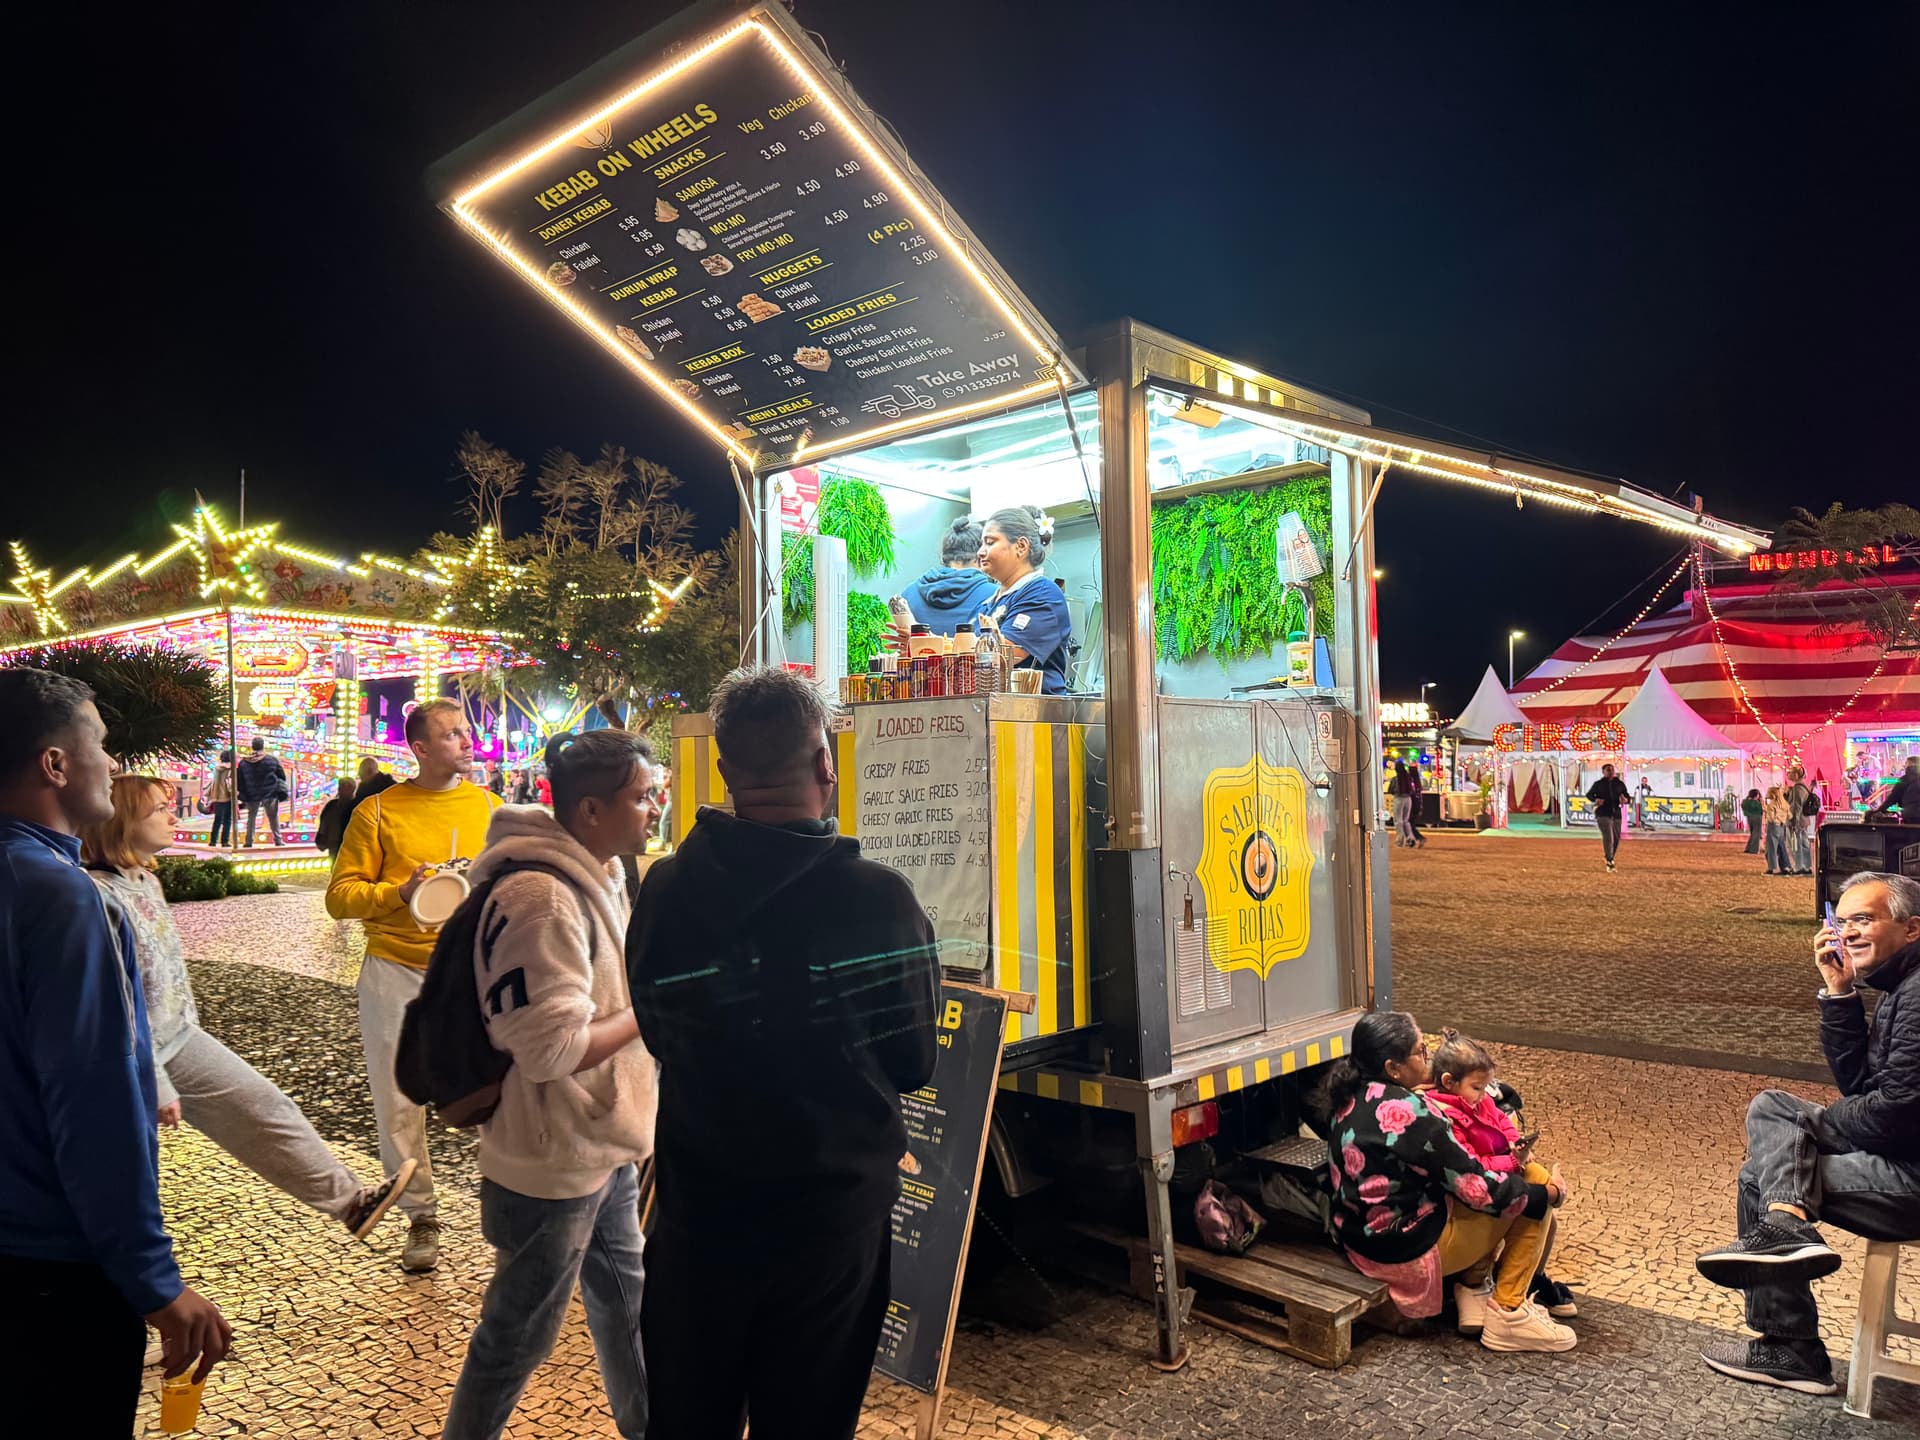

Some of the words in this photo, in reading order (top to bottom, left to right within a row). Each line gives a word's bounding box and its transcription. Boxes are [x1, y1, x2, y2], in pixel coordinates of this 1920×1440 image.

[737, 118, 765, 135] Veg
[768, 93, 814, 121] Chickan
[760, 141, 787, 160] 3.50
[798, 121, 826, 141] 3.90
[535, 169, 599, 212] KEBAB
[596, 151, 632, 177] ON
[627, 103, 718, 160] WHEELS
[653, 148, 707, 181] SNACKS
[675, 176, 719, 202] SAMOSA
[796, 179, 821, 197] 4.50
[834, 160, 861, 179] 4.90
[538, 217, 576, 241] DONER
[573, 198, 612, 222] KEBAB
[823, 209, 849, 226] 4.50
[863, 191, 888, 210] 4.90
[618, 215, 640, 231] 5.95
[708, 213, 746, 236] MO:MO
[868, 230, 884, 244] (4
[885, 218, 915, 237] Pic)
[630, 228, 653, 243] 5.95
[900, 234, 927, 252] 2.25
[559, 241, 591, 260] Chicken
[736, 247, 758, 263] FRY
[756, 233, 794, 255] MO:MO
[912, 249, 938, 265] 3.00
[572, 254, 601, 272] Falafel
[760, 254, 823, 285] NUGGETS
[609, 278, 649, 301] DURUM
[646, 265, 679, 286] WRAP
[774, 280, 813, 299] Chicken
[639, 287, 678, 308] KEBAB
[701, 295, 723, 308] 6.50
[787, 293, 821, 313] Falafel
[714, 307, 735, 320] 6.50
[805, 306, 857, 331] LOADED
[858, 293, 897, 314] FRIES
[641, 316, 674, 332] Chicken
[822, 329, 852, 346] Crispy
[852, 322, 877, 337] Fries
[653, 328, 683, 344] Falafel
[833, 341, 864, 358] Garlic
[863, 334, 893, 350] Sauce
[891, 325, 918, 342] Fries
[684, 356, 722, 373] KEBAB
[719, 346, 746, 361] BOX
[762, 353, 783, 367] 7.50
[844, 353, 880, 369] Cheesy
[878, 344, 908, 361] Garlic
[906, 336, 934, 352] Fries
[856, 364, 893, 379] Chicken
[893, 352, 928, 369] Loaded
[927, 345, 954, 361] Fries
[702, 372, 734, 387] Chicken
[773, 365, 795, 378] 7.50
[784, 375, 806, 388] 7.95
[916, 366, 965, 389] Take
[968, 352, 1020, 376] Away
[713, 383, 742, 397] Falafel
[955, 370, 1021, 394] 913335274
[746, 408, 778, 423] MENU
[776, 398, 813, 415] DEALS
[759, 423, 782, 435] Drink
[780, 421, 789, 429] &
[788, 416, 809, 428] Fries
[830, 416, 850, 428] 1.00
[769, 433, 795, 445] Water
[1749, 545, 1899, 571] MUNDIAL
[1380, 702, 1430, 721] ANIS
[876, 716, 924, 738] LOADED
[930, 715, 965, 734] FRIES
[1492, 720, 1626, 752] CIRCO
[864, 762, 897, 779] CRISPY
[902, 759, 930, 775] FRIES
[863, 790, 895, 807] GARLIC
[898, 786, 926, 804] SAUCE
[929, 783, 959, 800] FRIES
[1644, 797, 1711, 814] FBI
[862, 811, 891, 827] CHEESY
[894, 809, 923, 825] GARLIC
[926, 807, 954, 823] FRIES
[1219, 793, 1294, 846] SABORES
[1647, 812, 1709, 823] Automóveis
[860, 834, 893, 851] CHICKEN
[896, 832, 931, 848] LOADED
[931, 830, 961, 845] FRIES
[892, 853, 927, 868] CHICKEN
[930, 852, 956, 866] FRIES
[1238, 903, 1284, 945] RODAS
